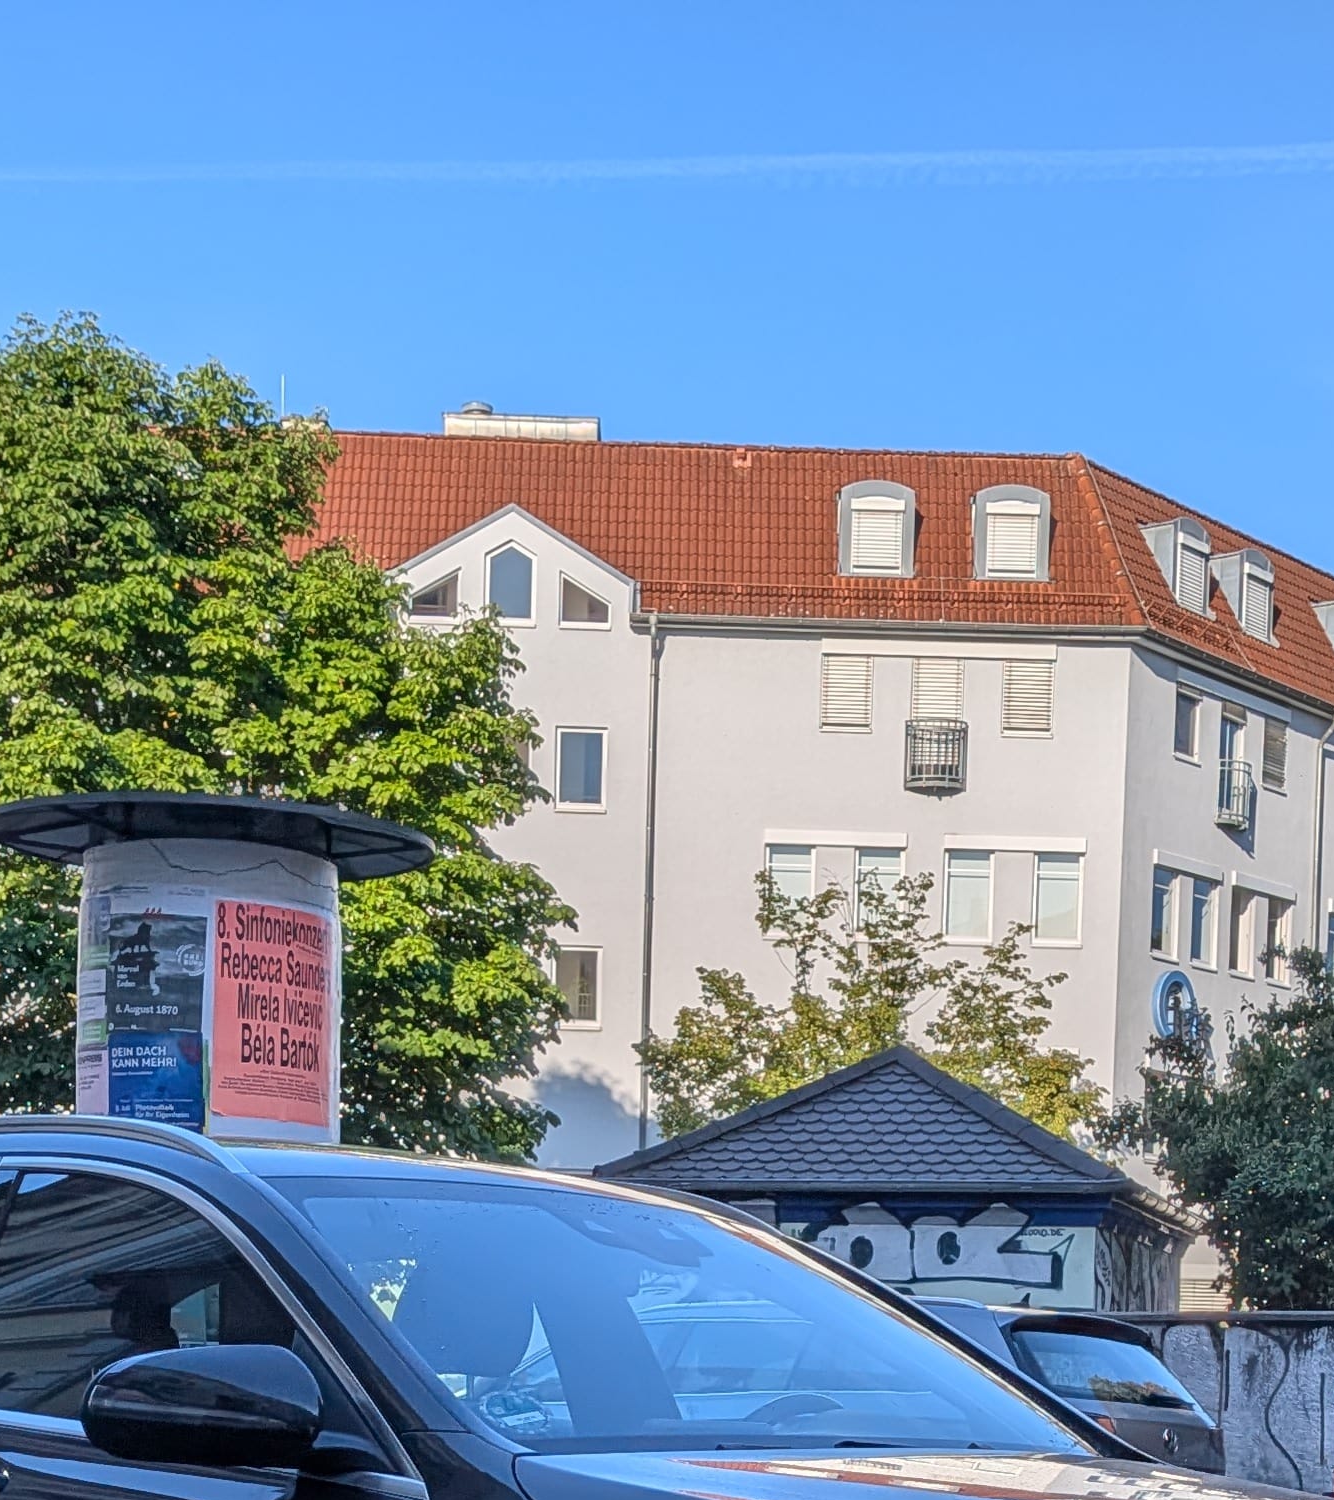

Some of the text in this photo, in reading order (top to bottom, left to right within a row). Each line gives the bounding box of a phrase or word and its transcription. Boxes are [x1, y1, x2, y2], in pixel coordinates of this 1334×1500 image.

[217, 902, 230, 939] 8.
[220, 941, 282, 984] Rebecca
[123, 1004, 154, 1016] August
[156, 1005, 178, 1015] 1870
[237, 982, 279, 1022] Mirela
[111, 1046, 166, 1058] DEIN DACH
[111, 1057, 139, 1069] KANN
[141, 1057, 177, 1067] MEHR!
[241, 1023, 319, 1072] Béla Bartók
